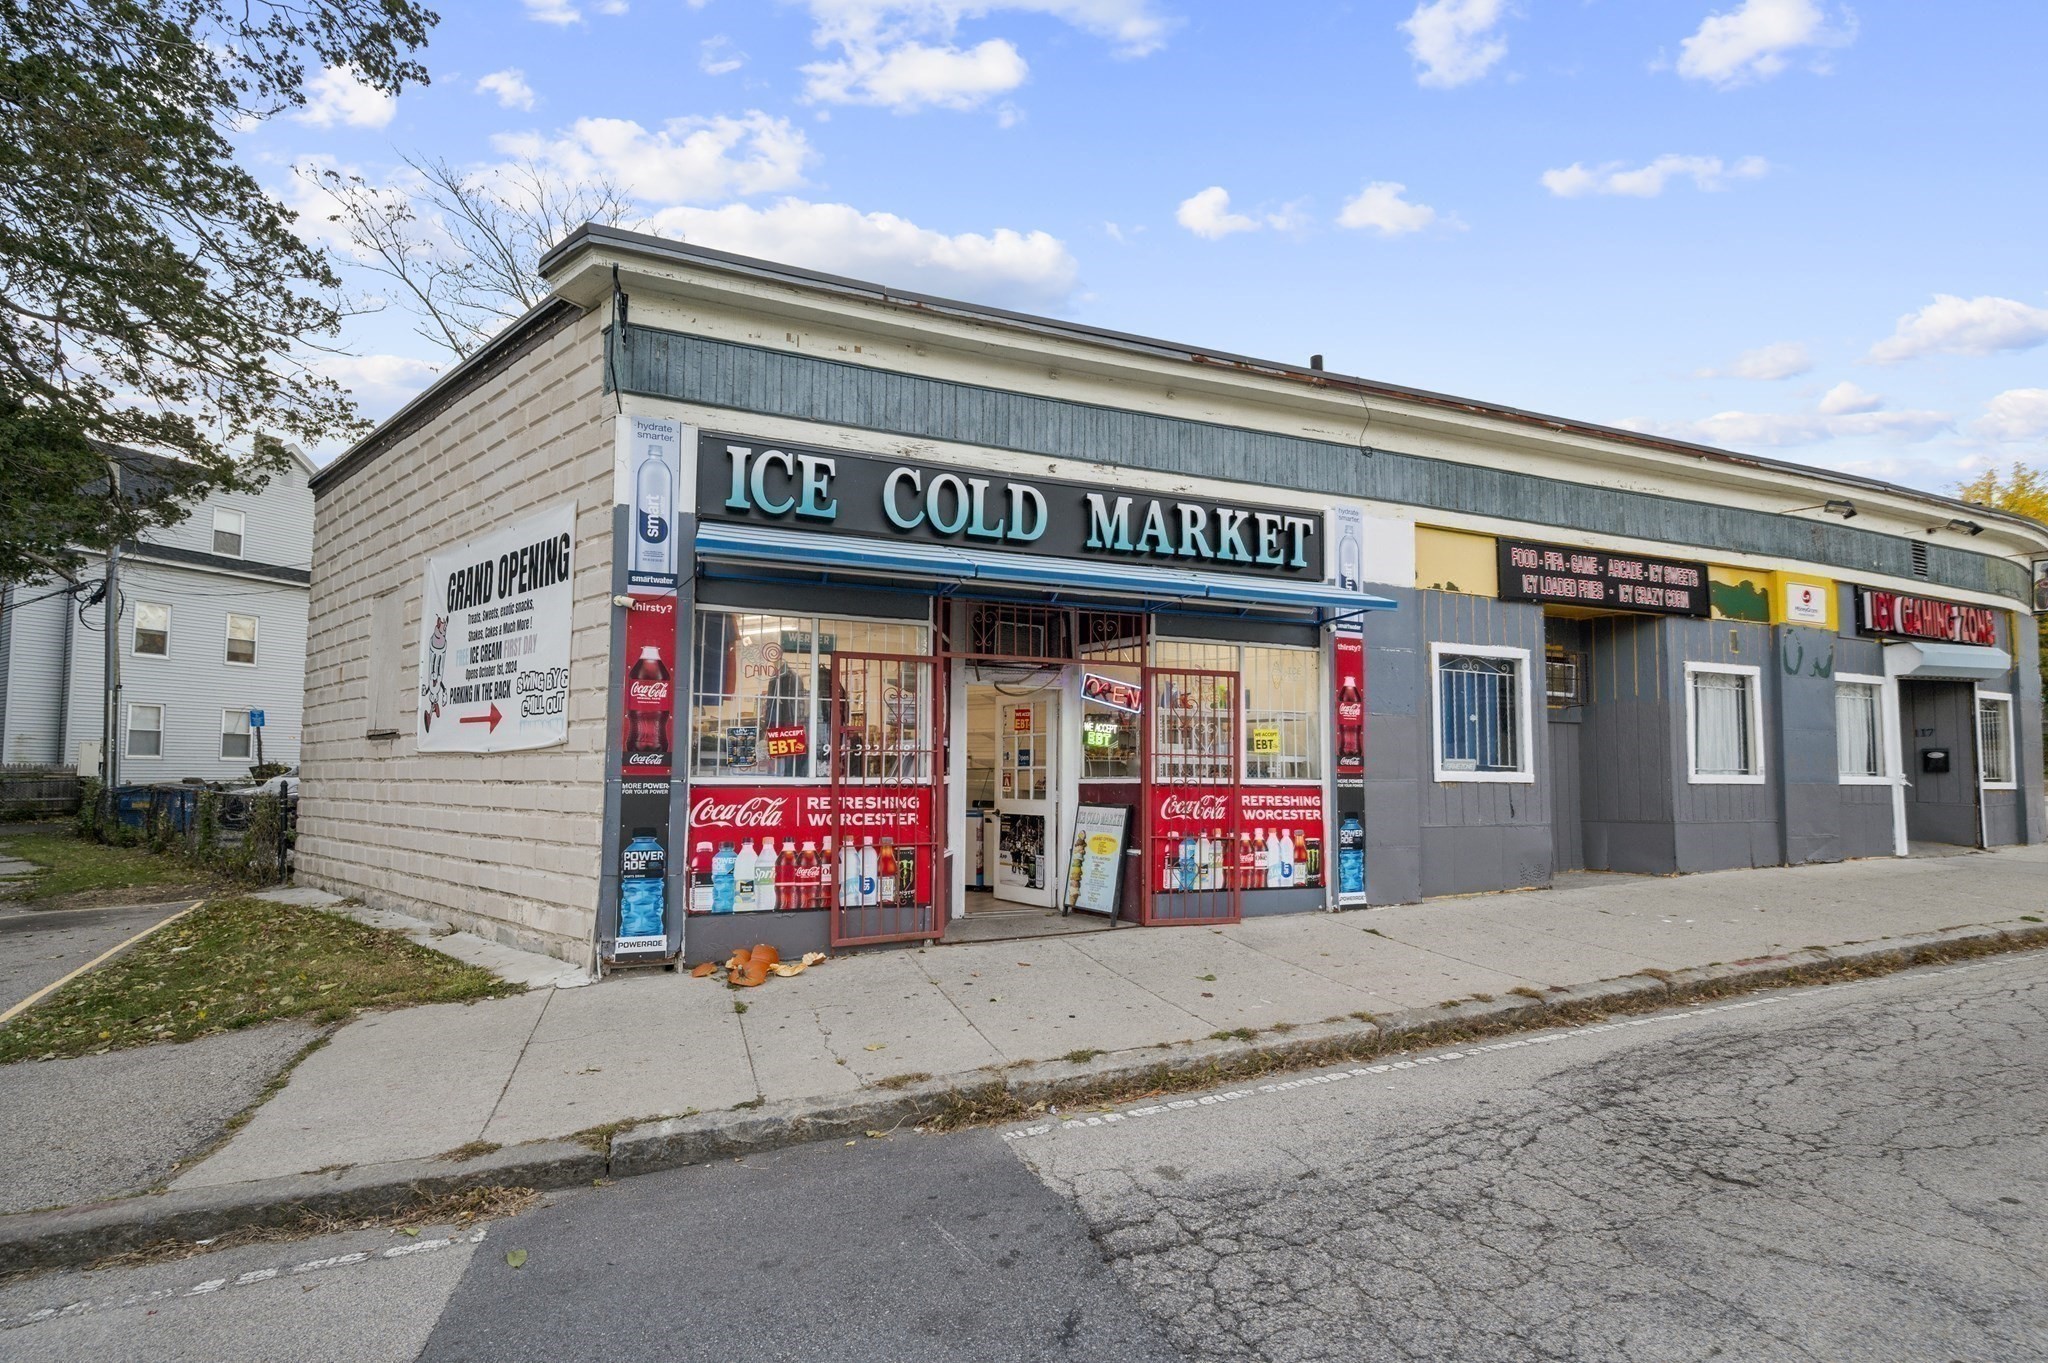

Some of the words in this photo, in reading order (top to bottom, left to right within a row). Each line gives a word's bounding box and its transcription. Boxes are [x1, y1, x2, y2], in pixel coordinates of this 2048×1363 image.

[637, 421, 672, 433] hydrate
[637, 431, 674, 442] smarter.
[725, 444, 838, 520] ICE
[882, 466, 1048, 542] COLD
[1086, 492, 1315, 569] MARKET
[1338, 508, 1358, 516] hydrate
[645, 494, 659, 538] smart
[447, 559, 493, 614] GRAND
[499, 532, 570, 599] OPENING
[1511, 547, 1538, 569] FOOD
[1571, 554, 1598, 575] GAME
[1608, 559, 1643, 580] ARCADE
[1648, 564, 1663, 582] ICY
[1664, 566, 1698, 587] SWEETS
[632, 576, 673, 584] smartwater
[1344, 562, 1352, 591] mart
[1522, 574, 1538, 593] ICY
[1540, 575, 1577, 597] LOADED
[1578, 580, 1604, 599] FRIES
[1619, 584, 1633, 602] ICY
[1635, 586, 1664, 606] CRAZY
[1665, 589, 1690, 608] CORN
[482, 607, 499, 621] Sweets,
[500, 602, 514, 617] exotic
[515, 598, 534, 613] snacks,
[503, 620, 515, 634] Much
[1894, 596, 1955, 640] GAMING
[1952, 606, 1995, 646] ZONE
[788, 632, 830, 645] WERER
[456, 647, 469, 667] FREE
[469, 646, 479, 664] ICE
[480, 641, 502, 662] CREAM
[504, 637, 521, 658] FIRST
[523, 634, 538, 655] DAY
[1337, 644, 1361, 652] thirsty?
[466, 668, 478, 681] Opens
[479, 664, 496, 678] October
[516, 671, 544, 694] SWING
[546, 668, 561, 691] BY
[450, 685, 473, 704] PARKING
[474, 683, 480, 702] IN
[482, 682, 493, 701] THE
[494, 680, 511, 699] BACK
[631, 681, 668, 698] Coca-Cola
[1086, 678, 1140, 708] OPEN
[521, 695, 544, 717] CHILL
[546, 691, 565, 715] OUT
[1015, 719, 1029, 729] EBT
[1084, 722, 1093, 731] WE
[780, 729, 803, 737] ACCEPT
[769, 739, 797, 754] EBT
[1256, 739, 1273, 749] EBT
[629, 753, 664, 765] Coca-Cola
[807, 797, 919, 809] RERESHING
[1241, 795, 1321, 807] REFRESHING
[690, 797, 788, 828] Coca-Cola
[1242, 809, 1322, 821] WORCESTER
[624, 851, 664, 861] POWER
[624, 861, 646, 870] ADE
[796, 867, 820, 877] Coca-Cola
[755, 867, 776, 881] Spri
[618, 940, 663, 948] POWERADE
